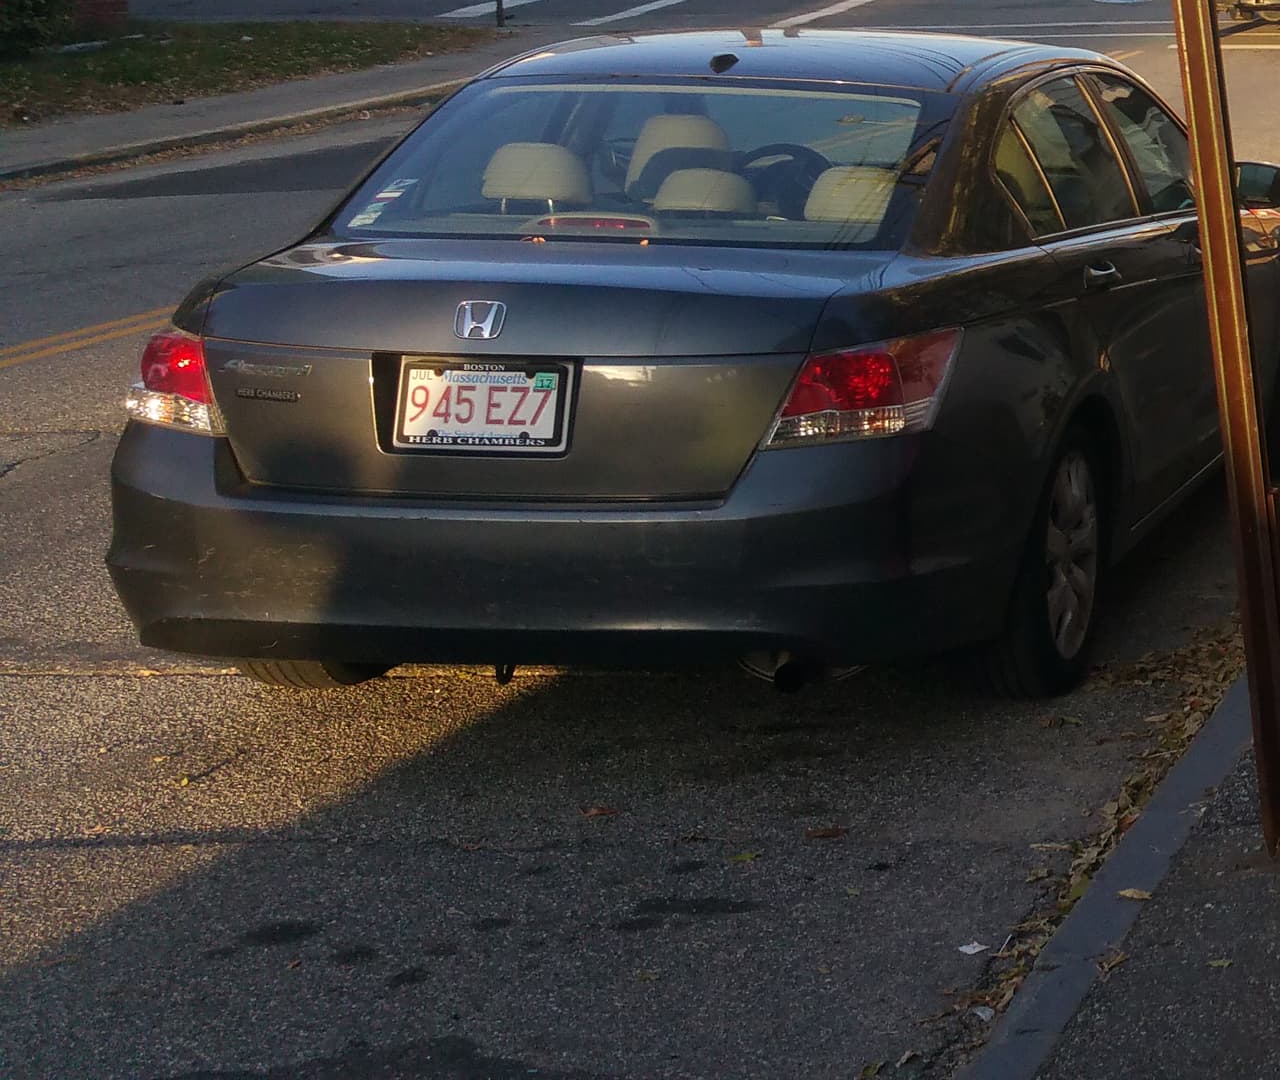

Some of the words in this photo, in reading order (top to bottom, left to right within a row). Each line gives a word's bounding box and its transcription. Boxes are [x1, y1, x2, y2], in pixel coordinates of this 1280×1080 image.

[463, 363, 505, 371] BOSTON
[411, 370, 433, 380] JUL
[441, 370, 528, 385] Massachusetts
[409, 385, 476, 424] 945
[485, 386, 553, 426] EZ7
[408, 435, 453, 445] HERB
[457, 436, 545, 447] CHAMBERS
